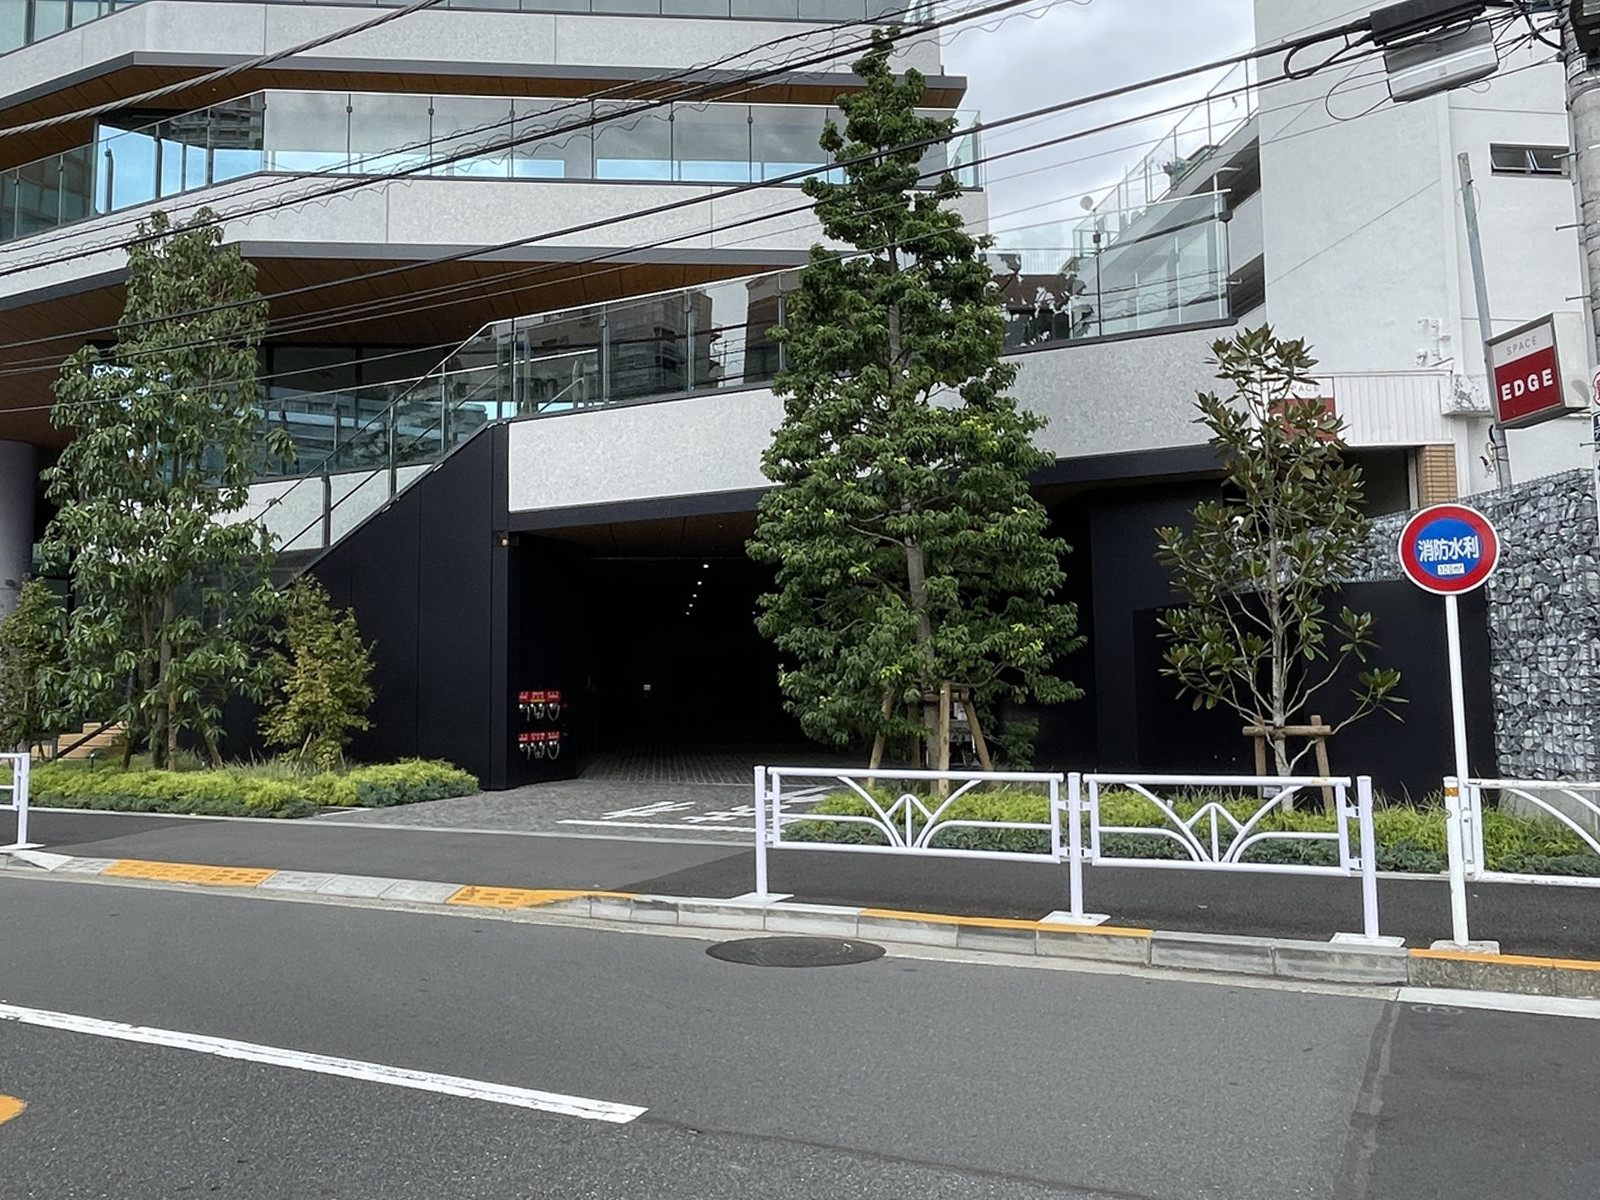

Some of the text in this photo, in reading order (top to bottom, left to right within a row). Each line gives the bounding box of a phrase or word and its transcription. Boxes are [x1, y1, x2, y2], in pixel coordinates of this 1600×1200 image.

[1505, 335, 1537, 356] SPACE
[1501, 368, 1554, 401] EDGE
[1417, 535, 1480, 562] 消防水利
